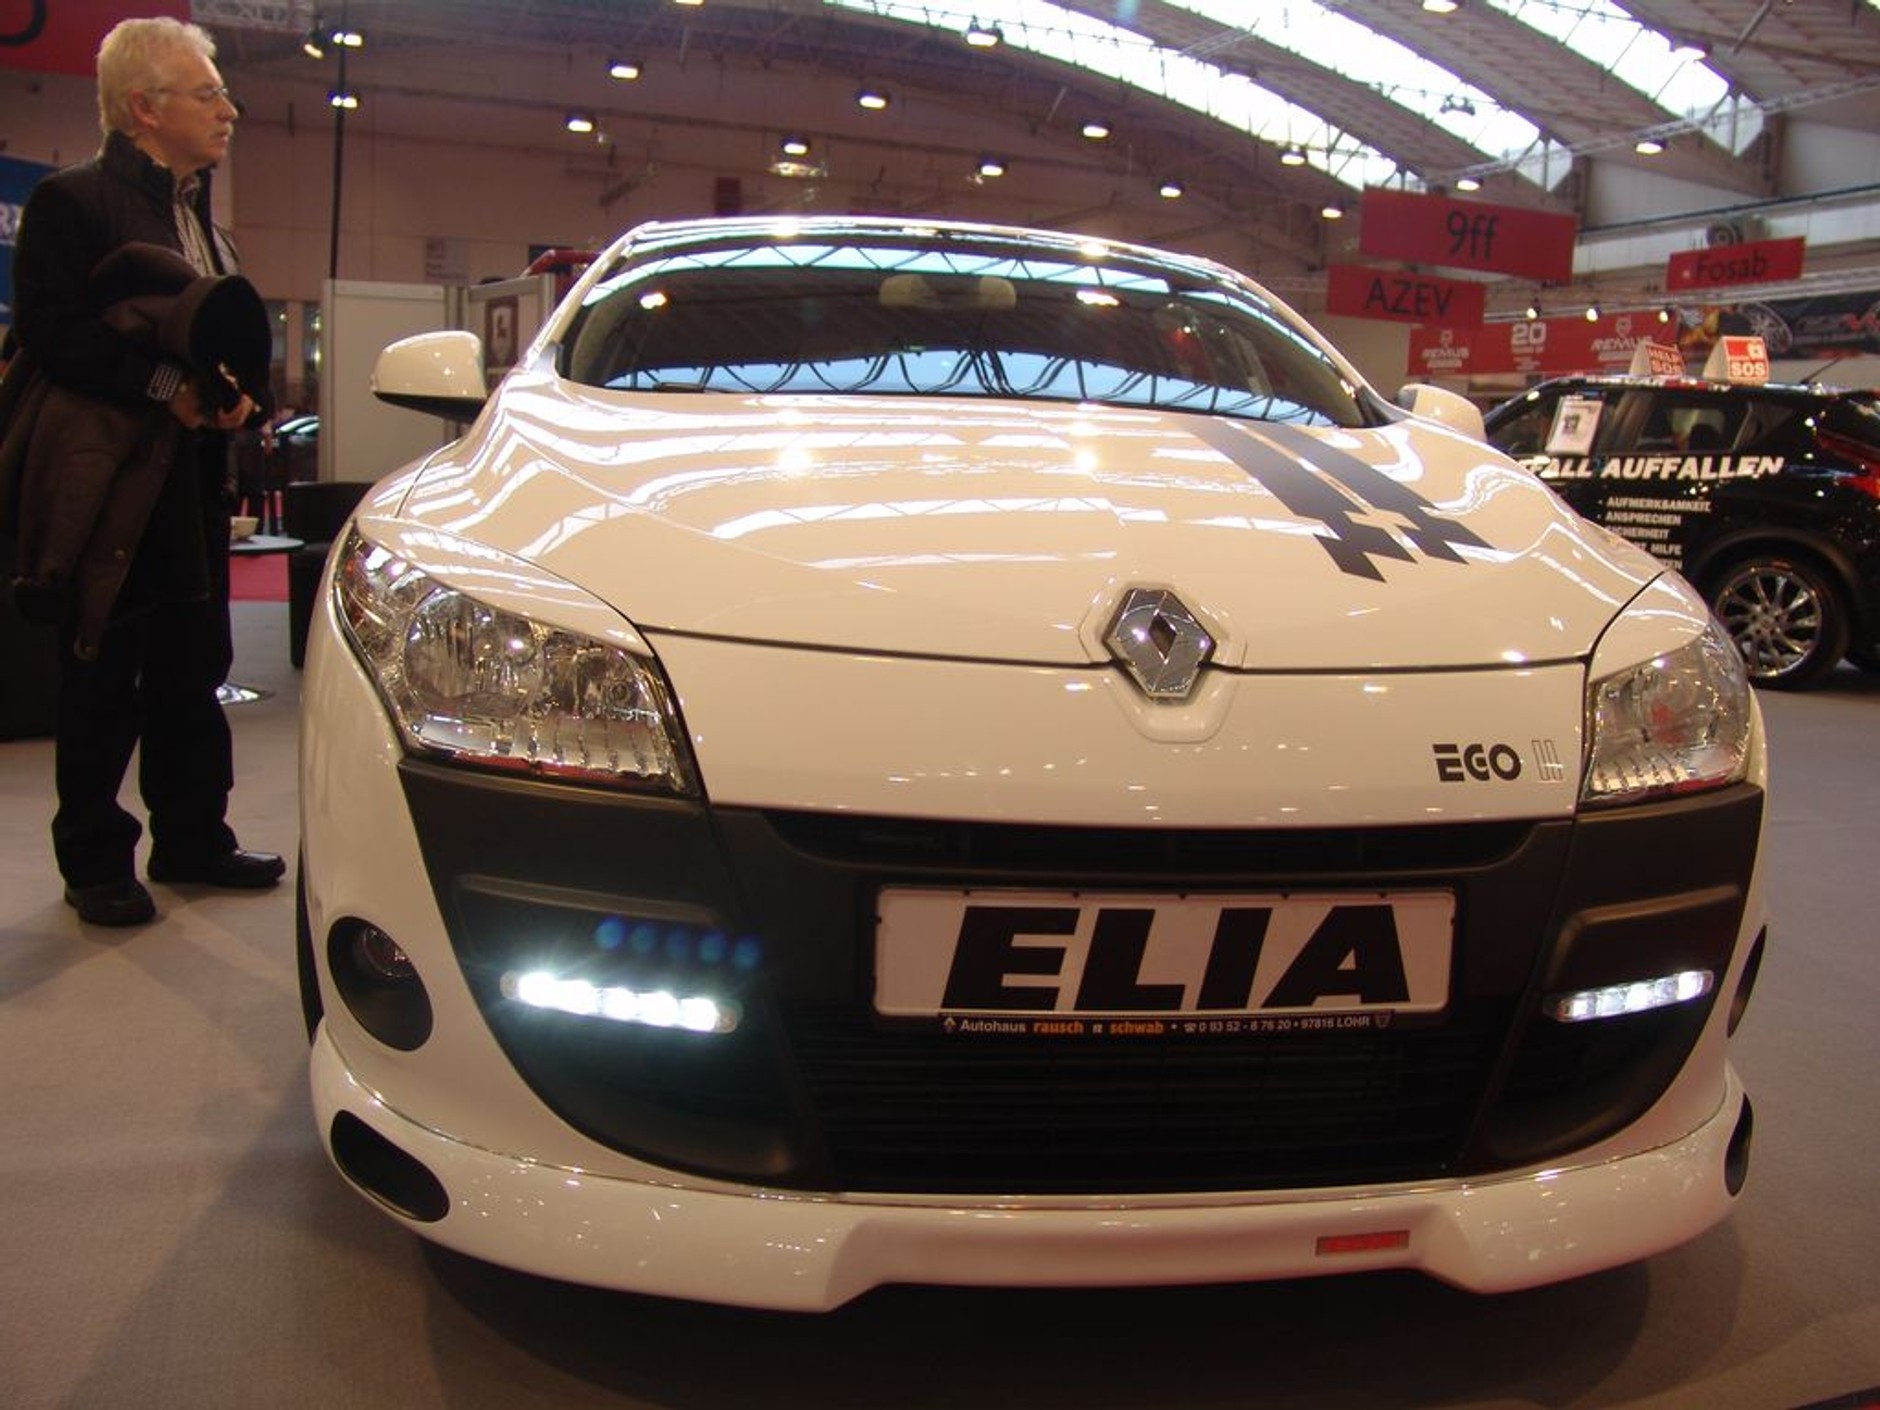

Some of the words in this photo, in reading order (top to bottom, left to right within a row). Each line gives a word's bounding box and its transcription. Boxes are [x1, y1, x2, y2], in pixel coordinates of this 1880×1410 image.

[1446, 209, 1499, 261] 9ff
[1365, 276, 1454, 316] AZEV
[1511, 321, 1547, 345] 20
[1731, 361, 1766, 376] SOS
[1600, 455, 1784, 480] AUFFALLEN
[1604, 511, 1681, 525] ANSPRECHEN
[1432, 743, 1522, 782] EGO
[940, 904, 1411, 1010] ELIA
[959, 1019, 1027, 1033] Autohaus
[1033, 1020, 1085, 1034] rausch
[1109, 1020, 1164, 1034] schwab
[1336, 1015, 1370, 1028] LOHR
